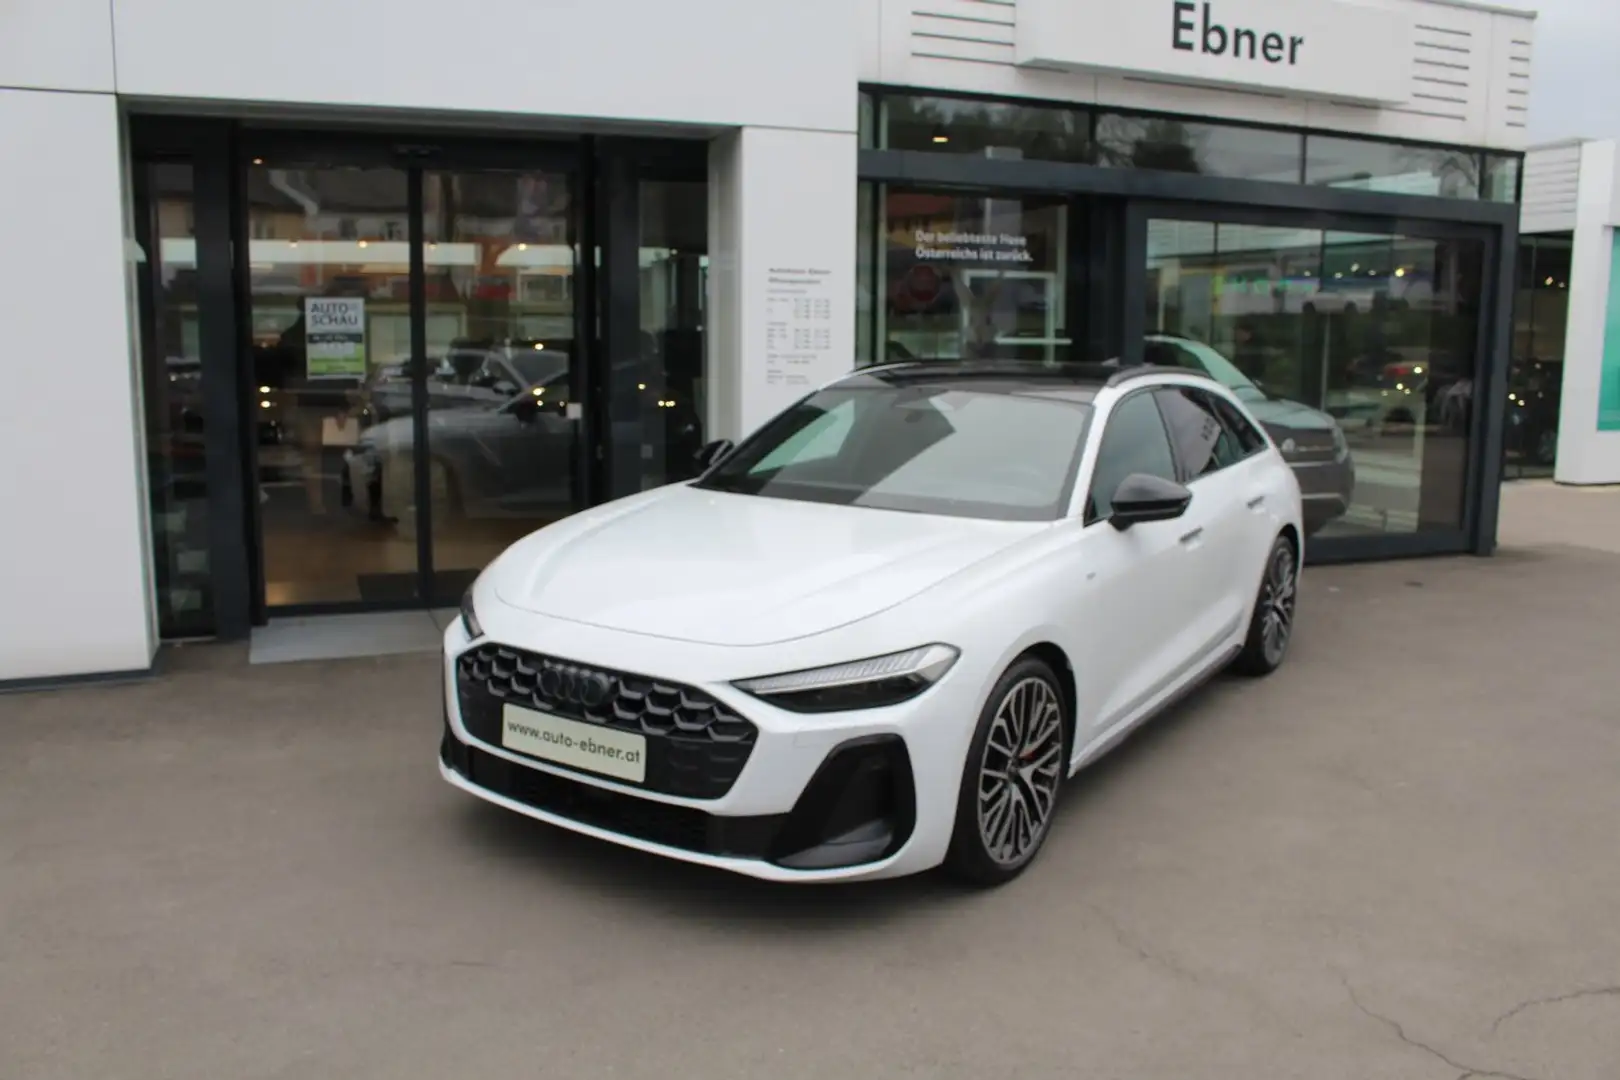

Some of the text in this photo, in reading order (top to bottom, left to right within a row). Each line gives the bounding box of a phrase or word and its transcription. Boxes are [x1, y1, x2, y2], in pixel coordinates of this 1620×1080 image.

[1172, 1, 1304, 65] Ebner
[915, 229, 934, 242] Der
[979, 248, 994, 260] ist
[311, 314, 358, 326] SCHAU
[507, 720, 641, 764] www.auto-ebner.at
